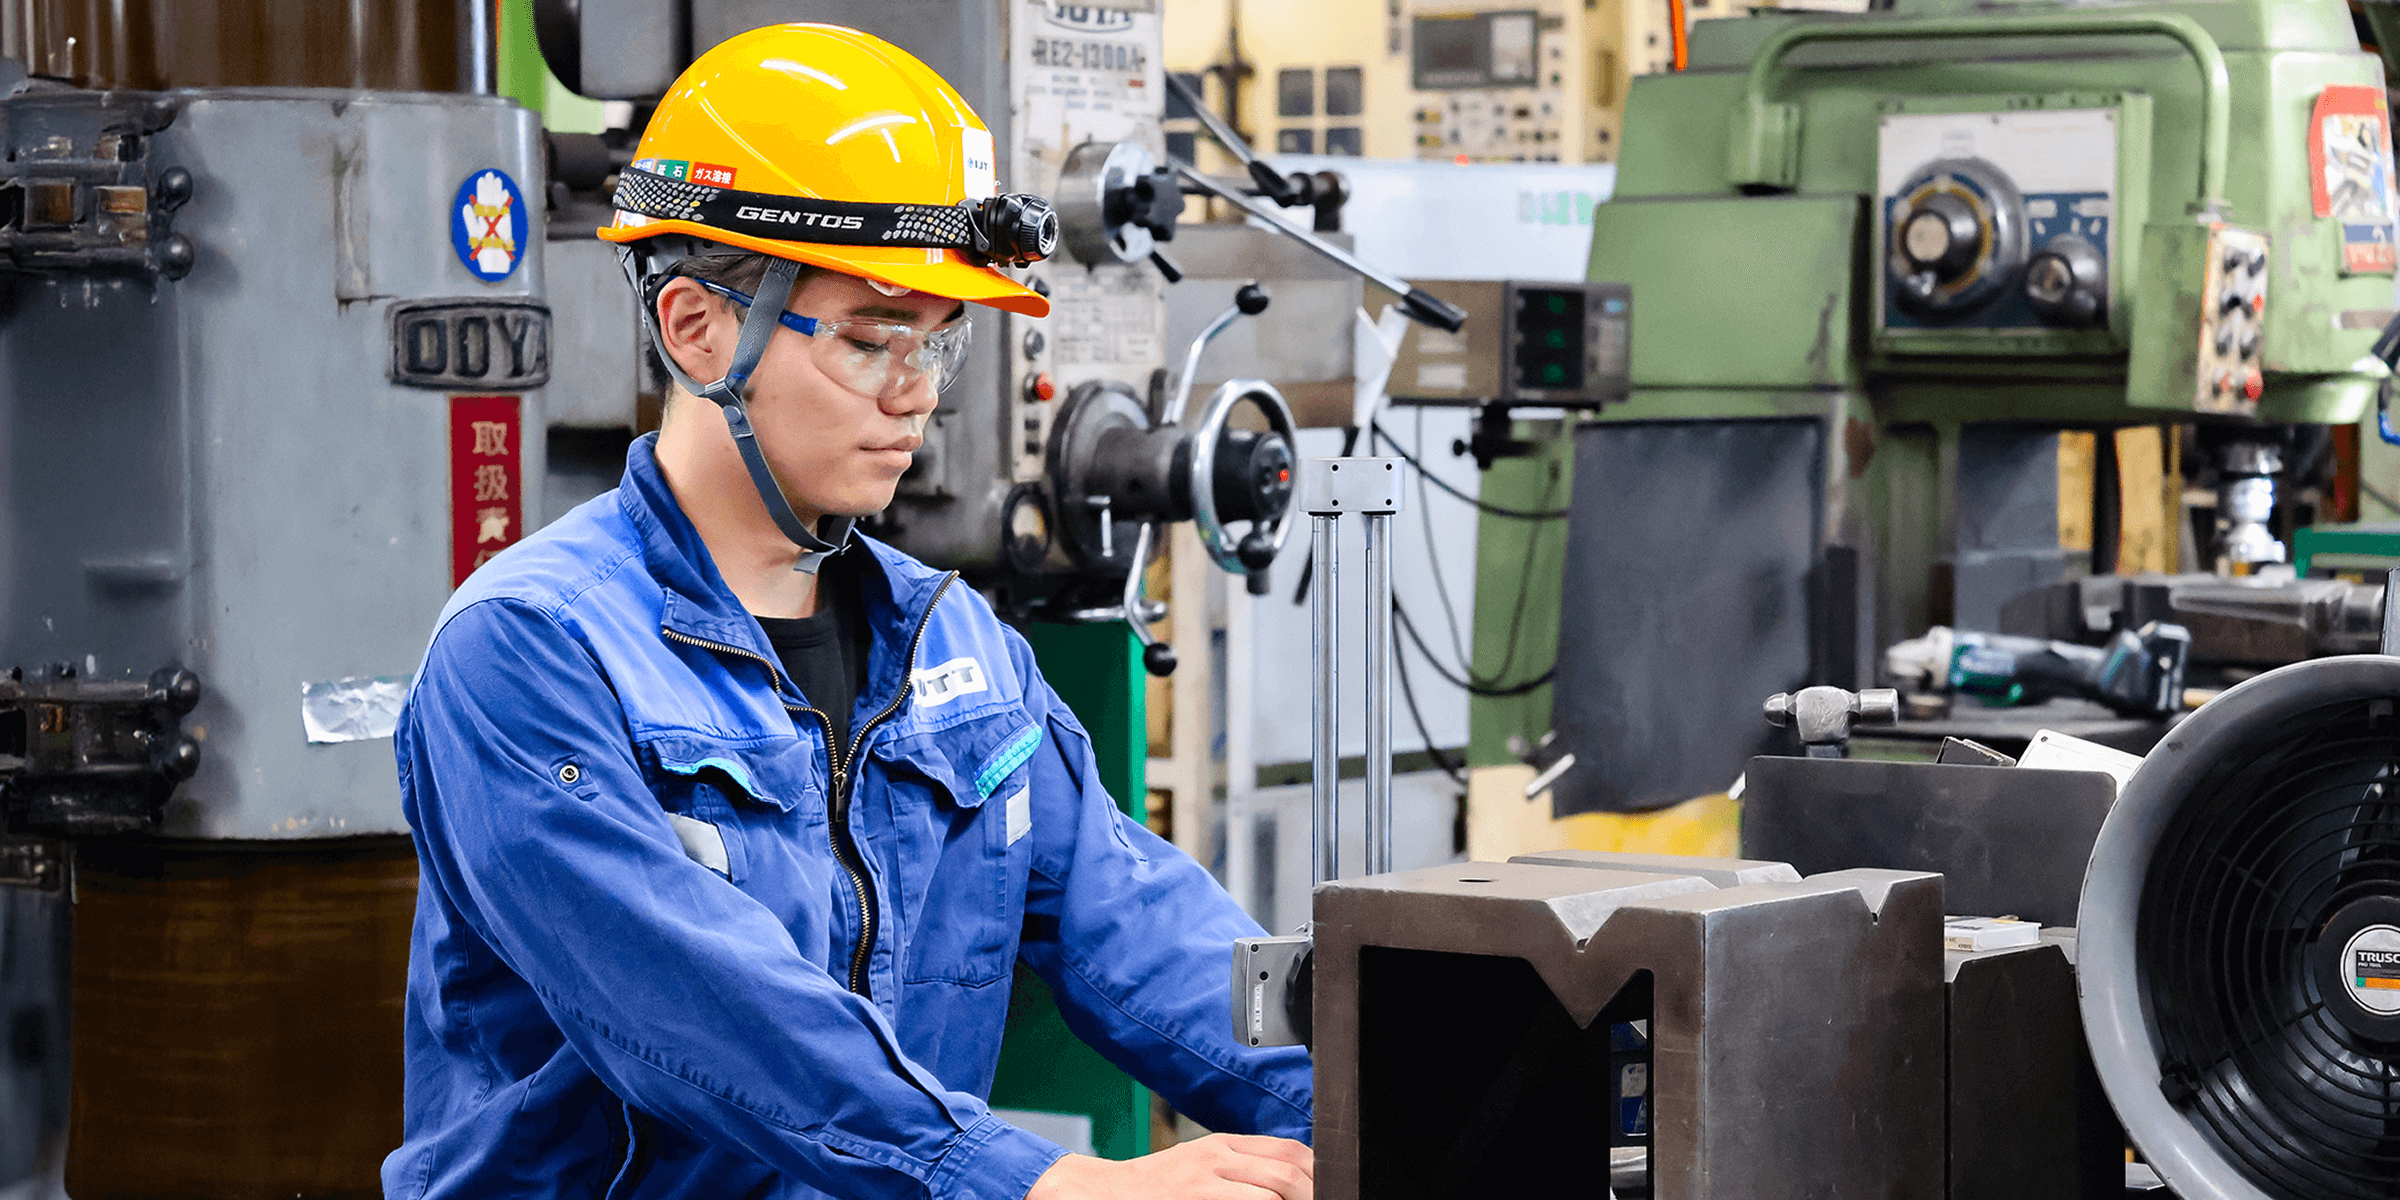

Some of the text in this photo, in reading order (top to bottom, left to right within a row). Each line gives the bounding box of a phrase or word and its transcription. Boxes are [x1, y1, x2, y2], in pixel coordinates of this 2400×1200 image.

[693, 166, 733, 185] ガス溶接
[735, 205, 865, 230] GENTOS
